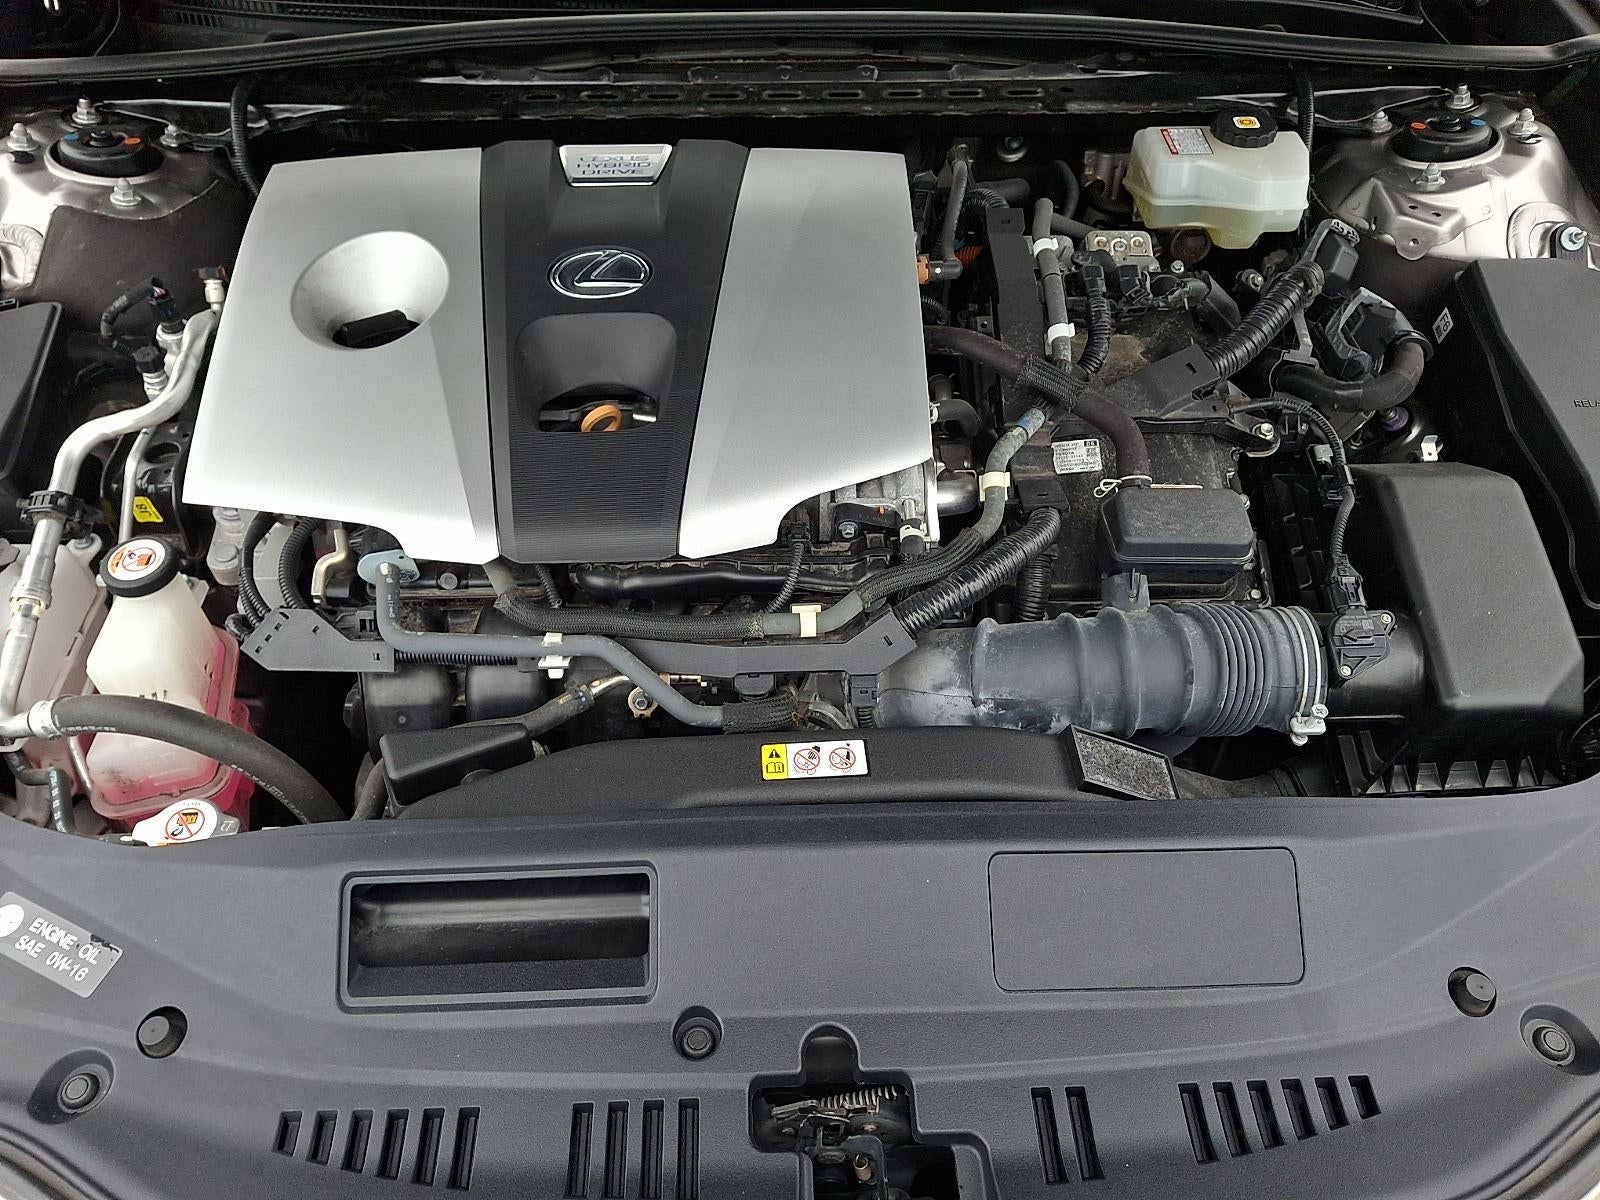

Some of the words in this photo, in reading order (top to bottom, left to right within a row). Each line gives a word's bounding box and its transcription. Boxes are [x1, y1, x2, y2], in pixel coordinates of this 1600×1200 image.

[14, 935, 46, 958] SAE
[28, 917, 78, 951] ENGINE
[78, 943, 101, 965] OIL
